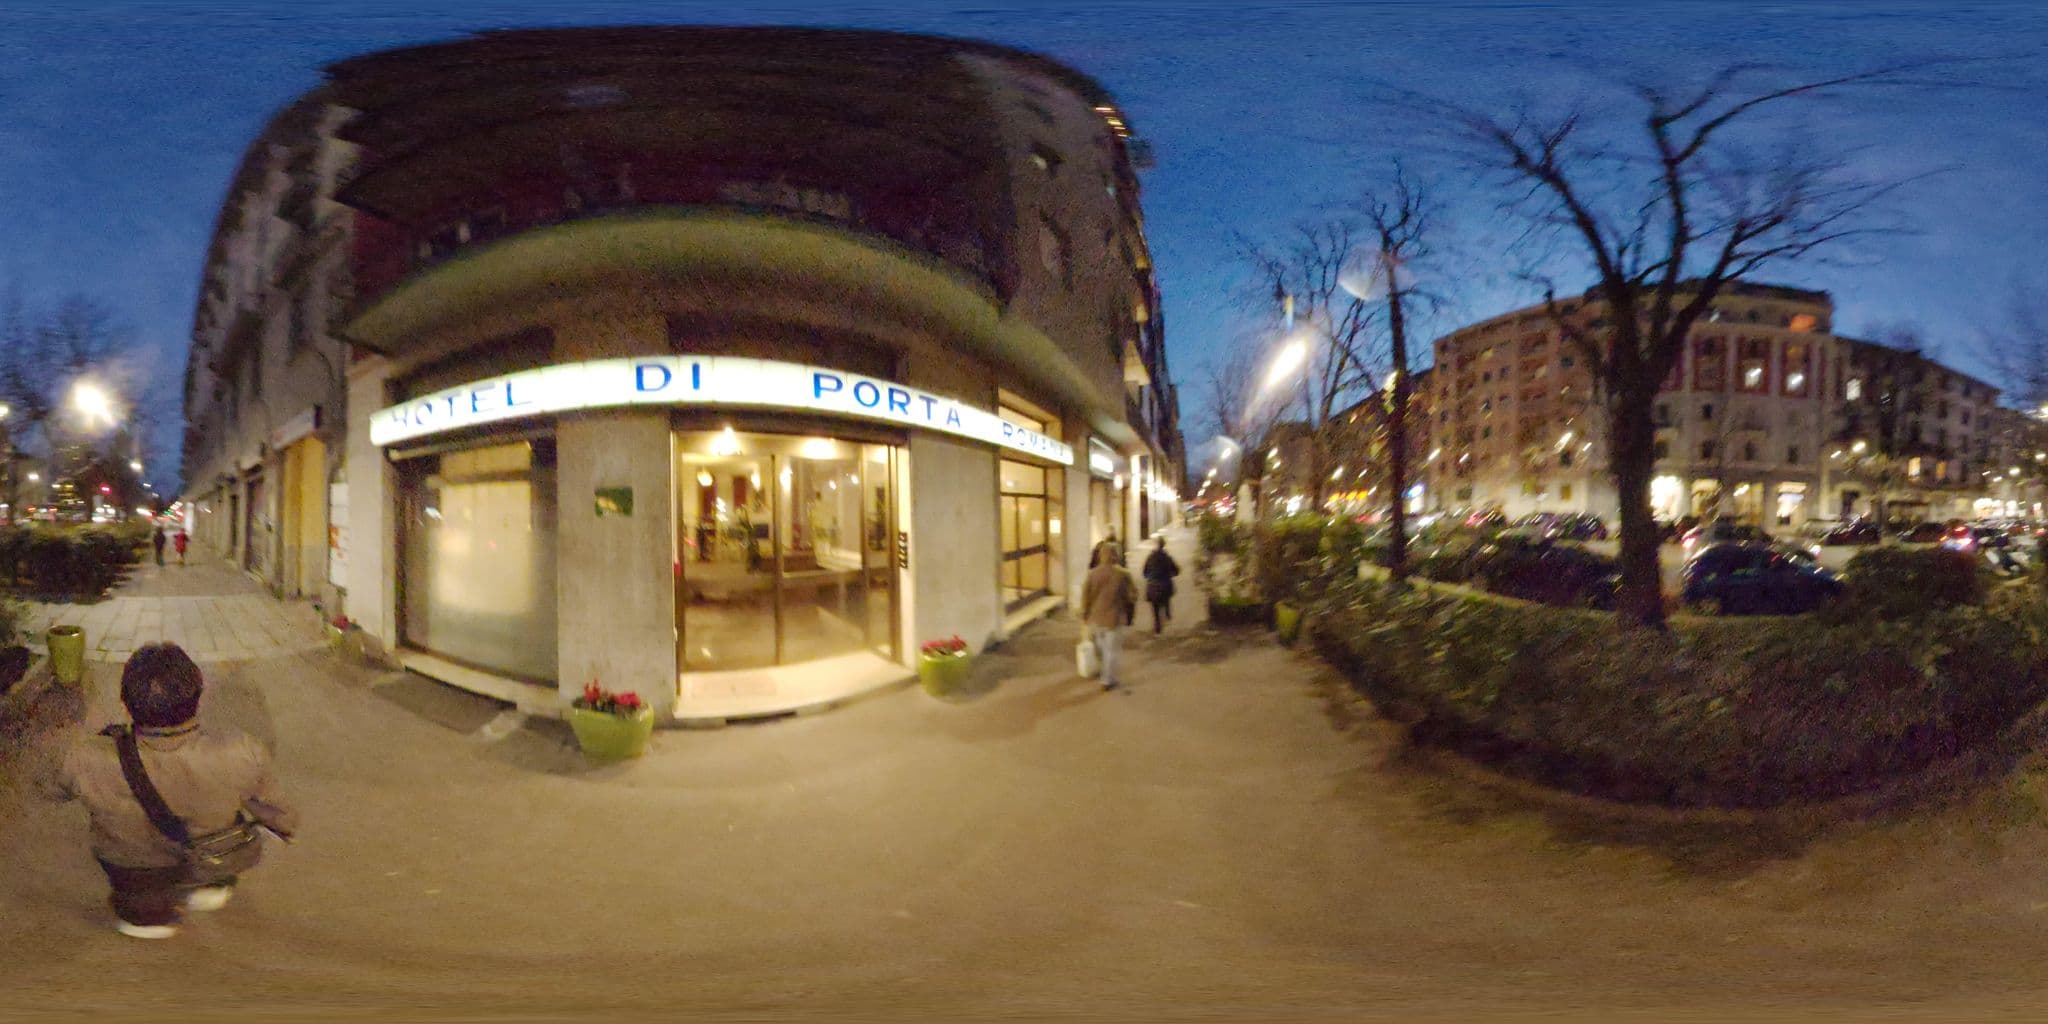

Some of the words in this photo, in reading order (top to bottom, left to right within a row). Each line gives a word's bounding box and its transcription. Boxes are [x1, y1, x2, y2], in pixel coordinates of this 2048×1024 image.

[391, 379, 533, 428] HOTEL
[635, 362, 701, 393] DI
[812, 371, 962, 429] PORTA
